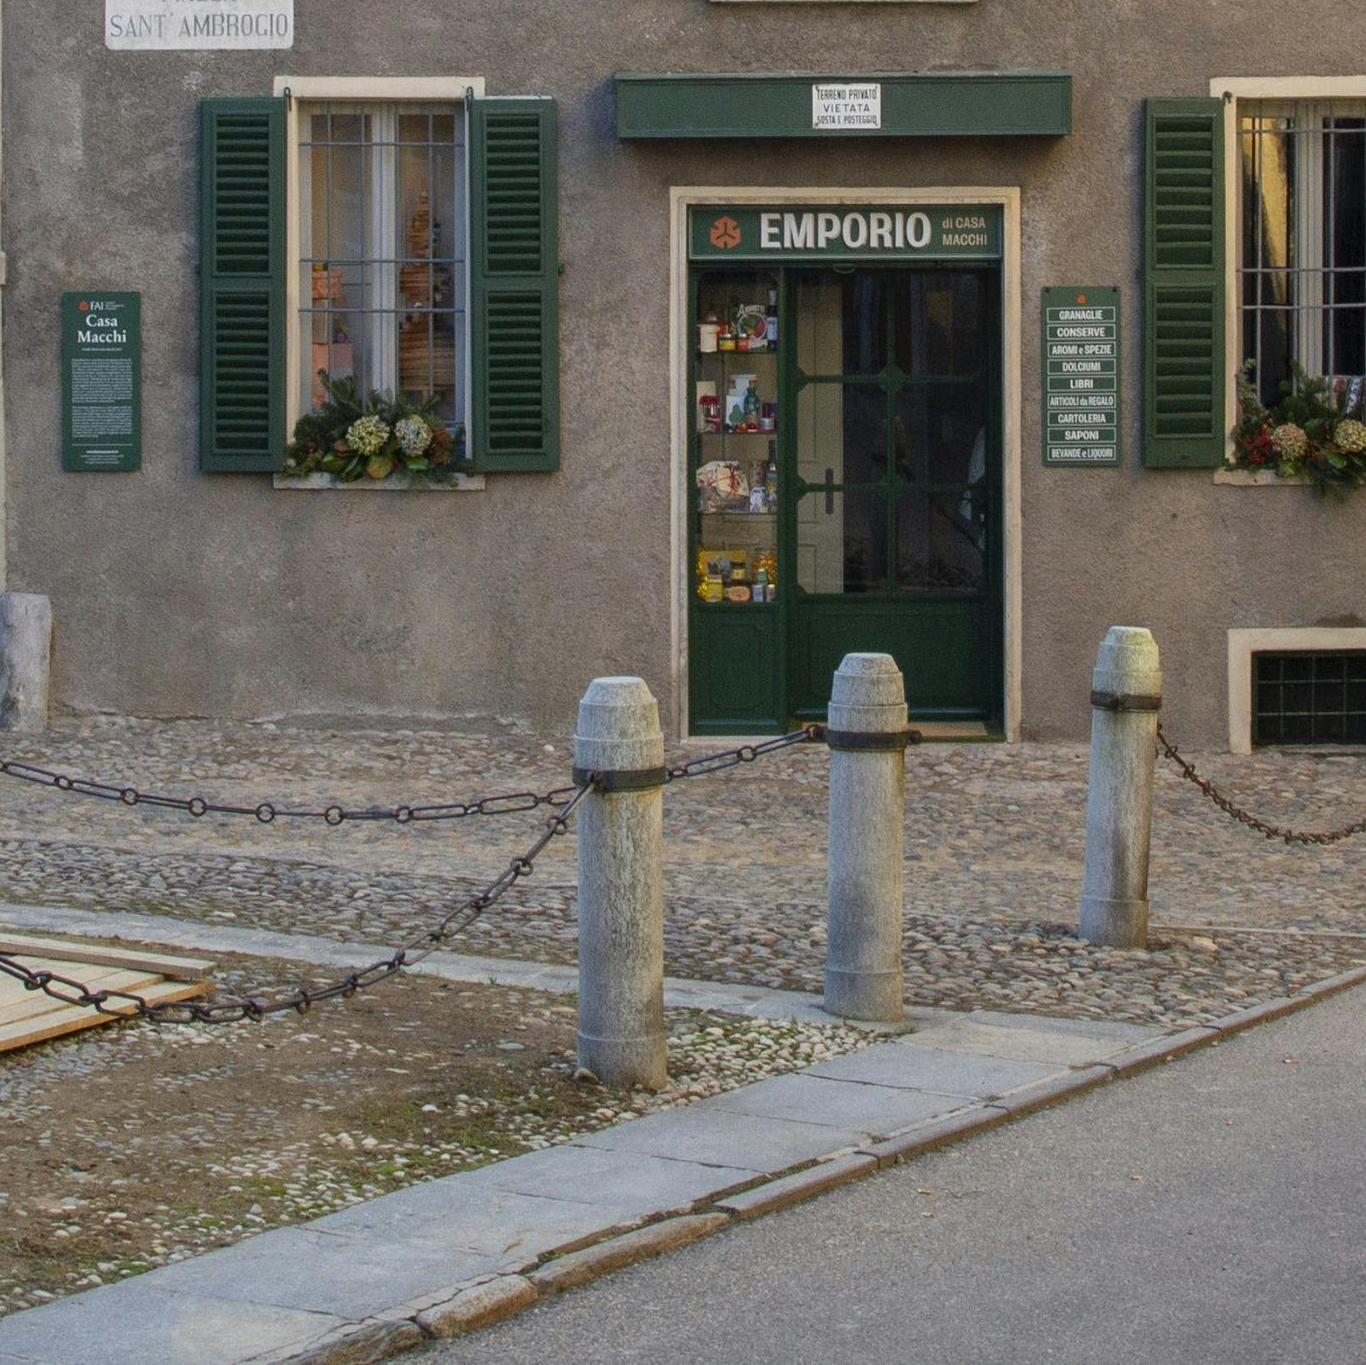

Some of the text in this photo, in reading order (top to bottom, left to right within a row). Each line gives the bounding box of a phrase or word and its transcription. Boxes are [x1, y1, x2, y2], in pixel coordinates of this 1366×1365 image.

[178, 12, 288, 37] AMBROGIO
[817, 89, 877, 100] TERRENO PRIVATO
[823, 103, 870, 113] VIETATA
[817, 115, 835, 124] SOSTA
[843, 115, 877, 124] POSTEGGIO
[942, 217, 986, 229] di CASA
[760, 212, 932, 249] EMPORIO
[942, 234, 988, 246] MACCHI
[90, 301, 103, 310] FAI
[1059, 310, 1103, 320] GRANAGLIE
[86, 314, 118, 327] Casa
[77, 329, 127, 343] Macchi
[1057, 327, 1106, 337] CONSERVE
[1052, 345, 1078, 354] AROMI
[1084, 344, 1112, 354] SPEZIE
[1062, 362, 1101, 372] DOLCIUMI
[1070, 379, 1094, 388] LIBRI
[1050, 397, 1079, 406] ARTICOLI
[1088, 396, 1114, 406] REGALO
[1058, 413, 1106, 423] CARTOLERIA
[1065, 431, 1099, 440] SAPONI
[1051, 448, 1081, 458] BEVANDE
[1087, 448, 1113, 459] LIQUORI
